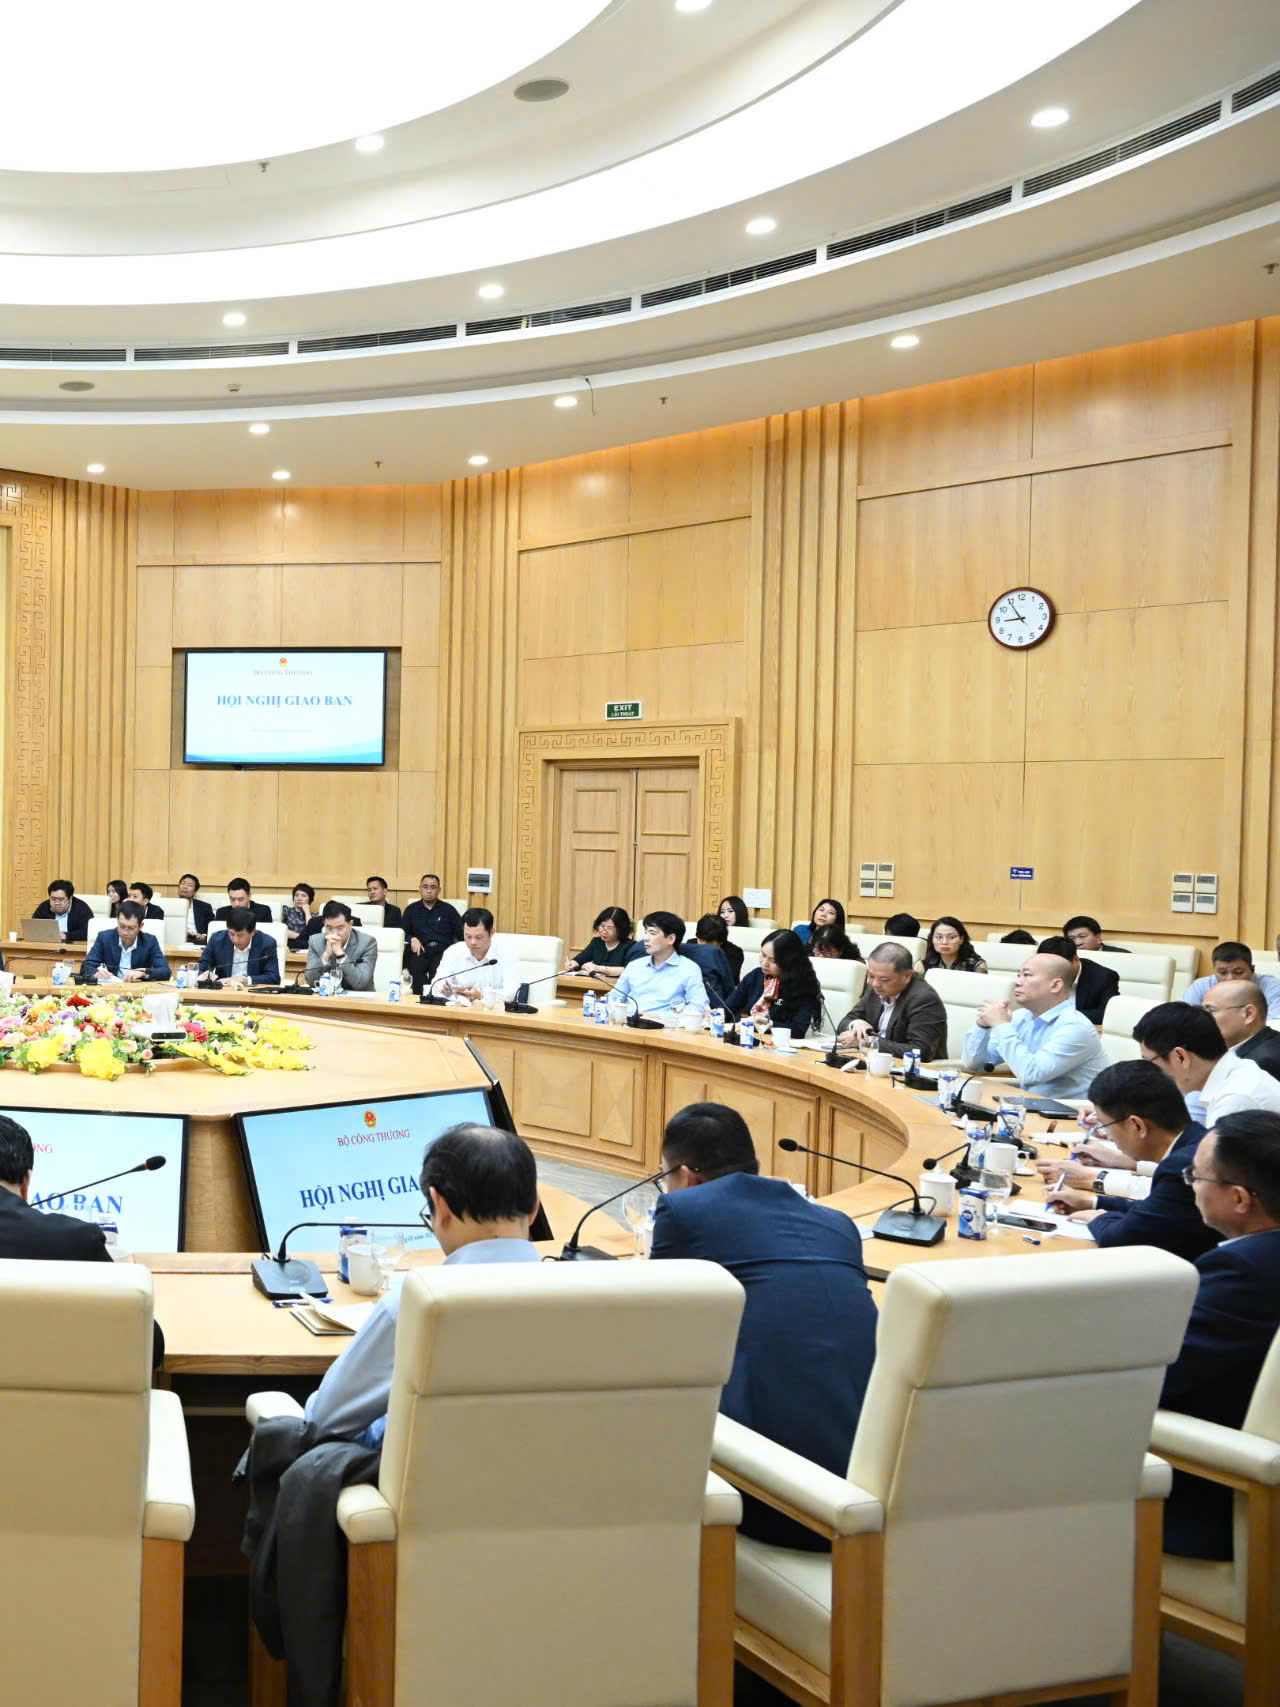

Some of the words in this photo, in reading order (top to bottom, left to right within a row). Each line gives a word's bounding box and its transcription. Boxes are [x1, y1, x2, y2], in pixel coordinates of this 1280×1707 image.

[1017, 593, 1026, 601] 12
[285, 695, 320, 706] GIAO
[325, 695, 352, 706] BAN
[337, 1135, 350, 1147] BỘ
[351, 1132, 375, 1145] CÔNG
[376, 1128, 410, 1142] THƯƠNG
[300, 1185, 335, 1210] HỘI
[338, 1179, 385, 1201] NGHỊ
[388, 1175, 420, 1195] GIA
[31, 1192, 65, 1211] AO
[73, 1194, 123, 1214] BAN
